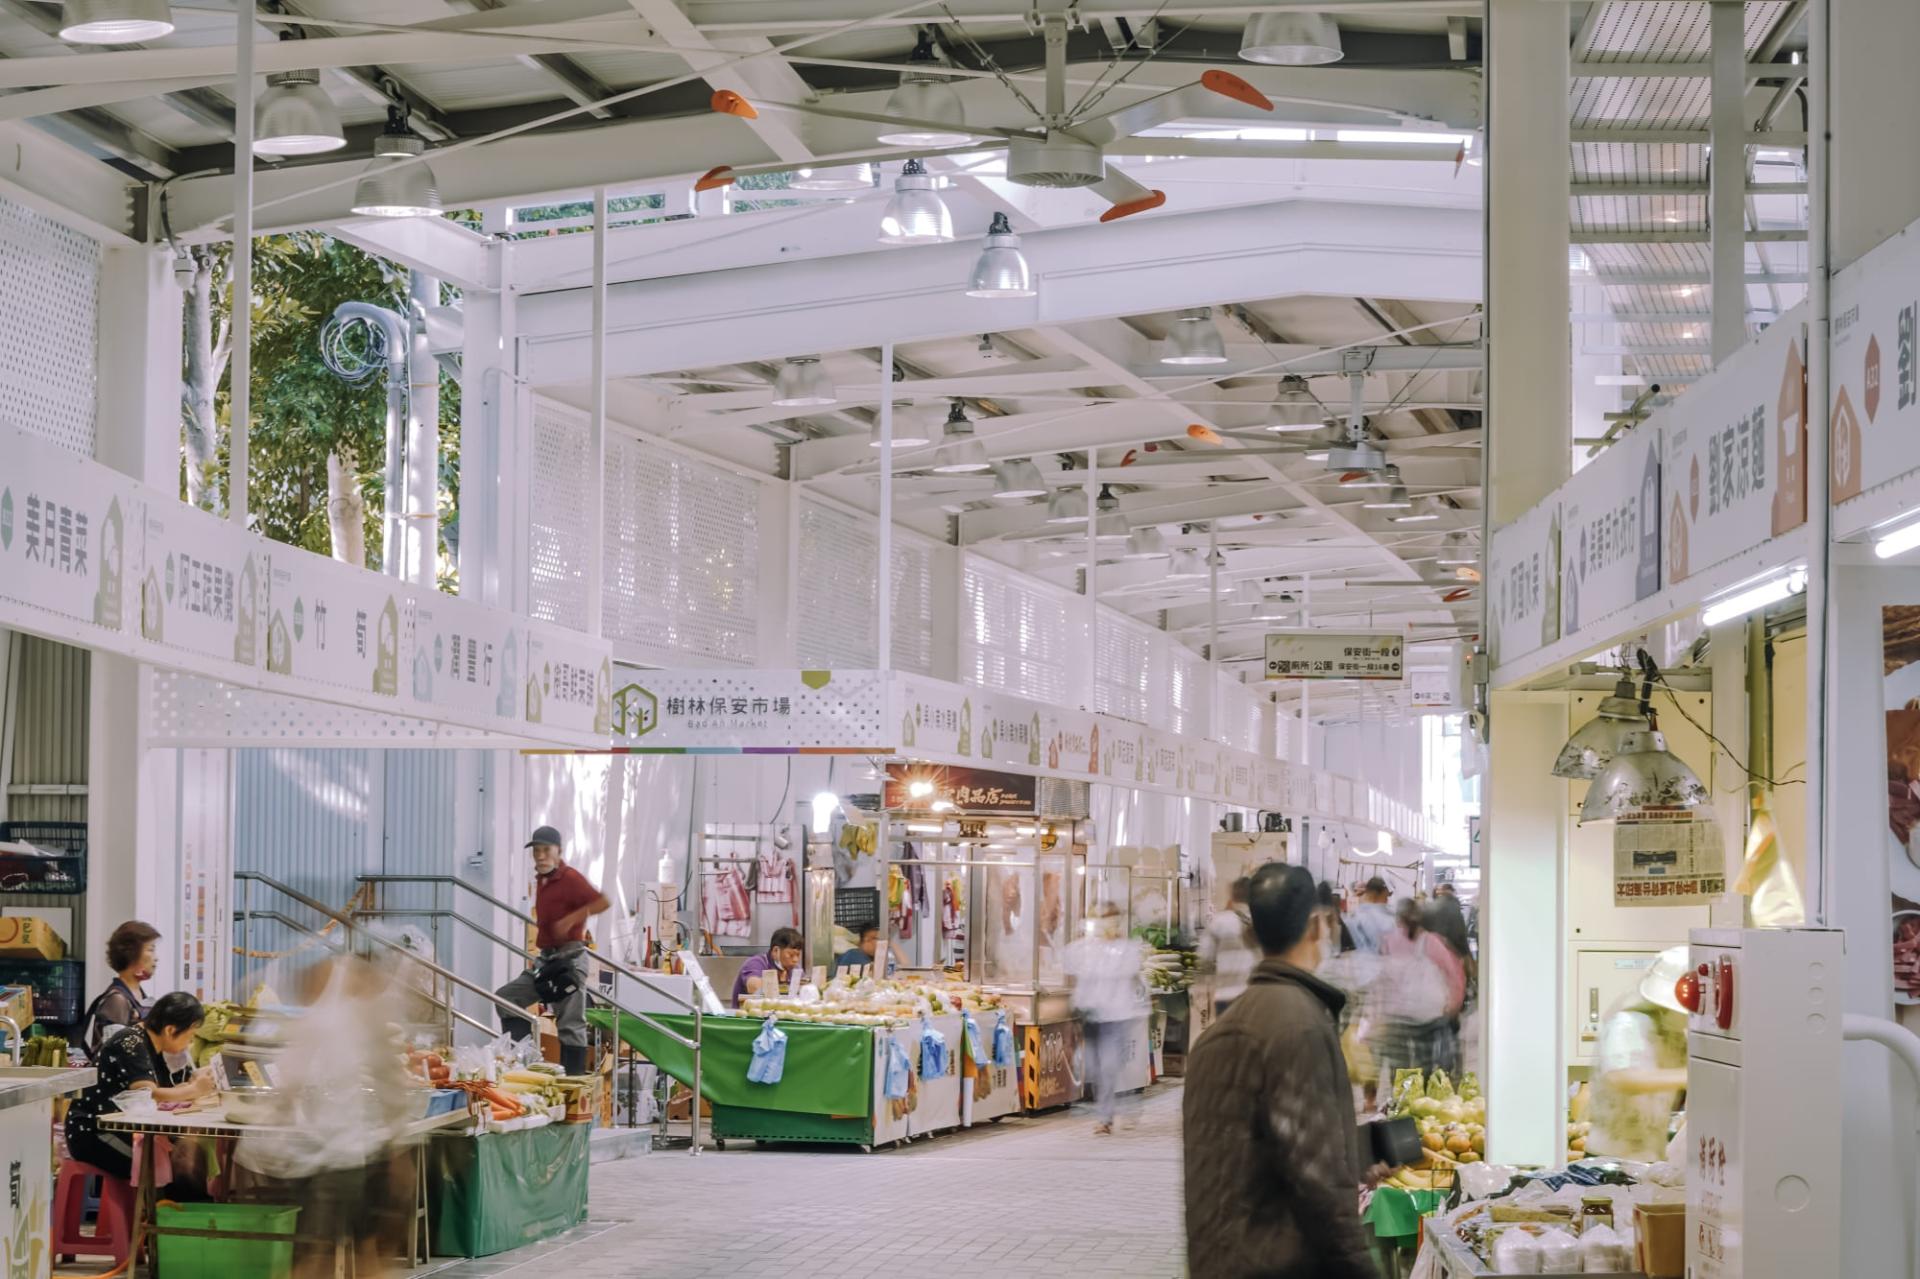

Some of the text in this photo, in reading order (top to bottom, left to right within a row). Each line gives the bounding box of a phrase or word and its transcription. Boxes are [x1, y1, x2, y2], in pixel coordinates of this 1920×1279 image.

[25, 492, 88, 577] 美月青菜
[1343, 647, 1390, 657] 保安街一段
[1313, 660, 1333, 671] 公園
[666, 695, 791, 716] 樹林保安市場
[687, 719, 708, 729] Bao
[729, 719, 768, 729] Market
